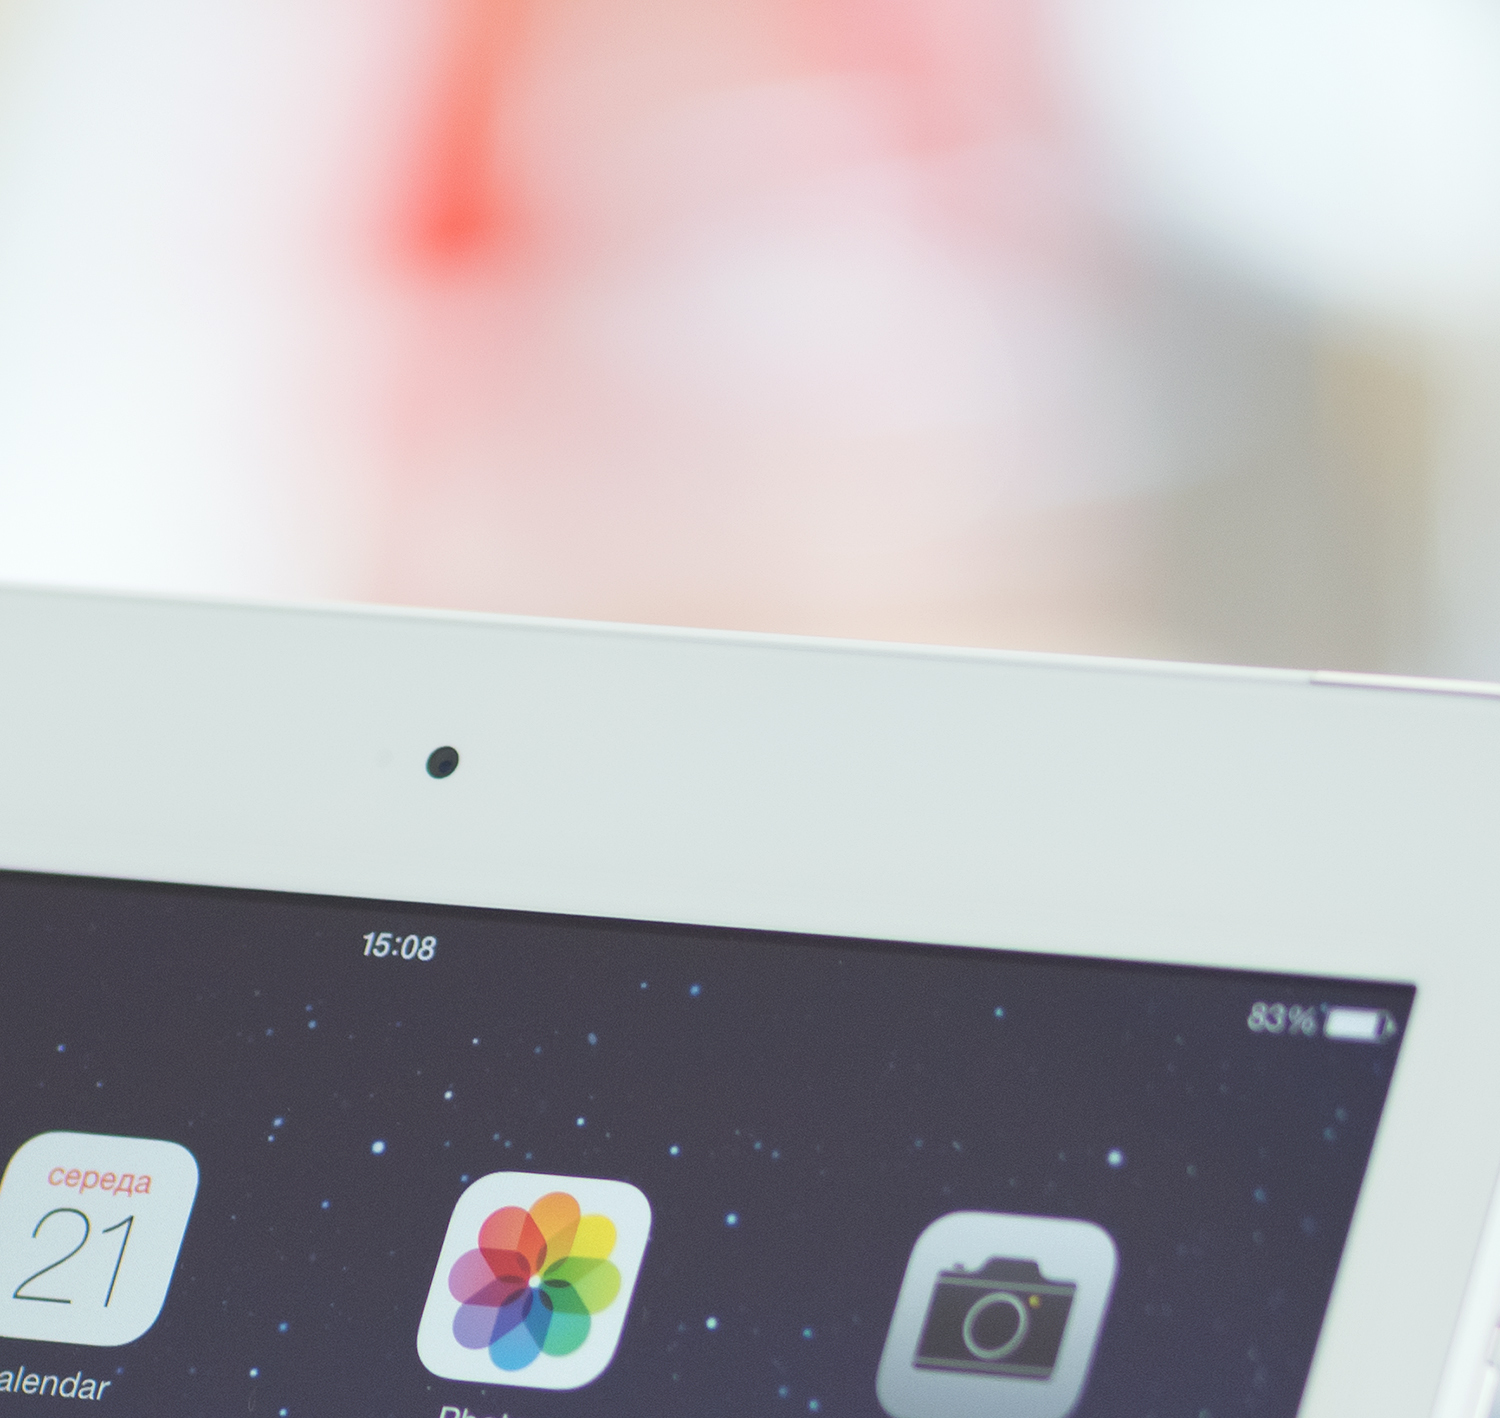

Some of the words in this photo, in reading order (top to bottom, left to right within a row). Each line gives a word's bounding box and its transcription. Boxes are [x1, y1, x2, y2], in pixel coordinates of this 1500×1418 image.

[362, 931, 438, 962] 15:08
[1247, 1002, 1317, 1036] 83%
[47, 1166, 152, 1198] середа
[12, 1207, 135, 1308] 21
